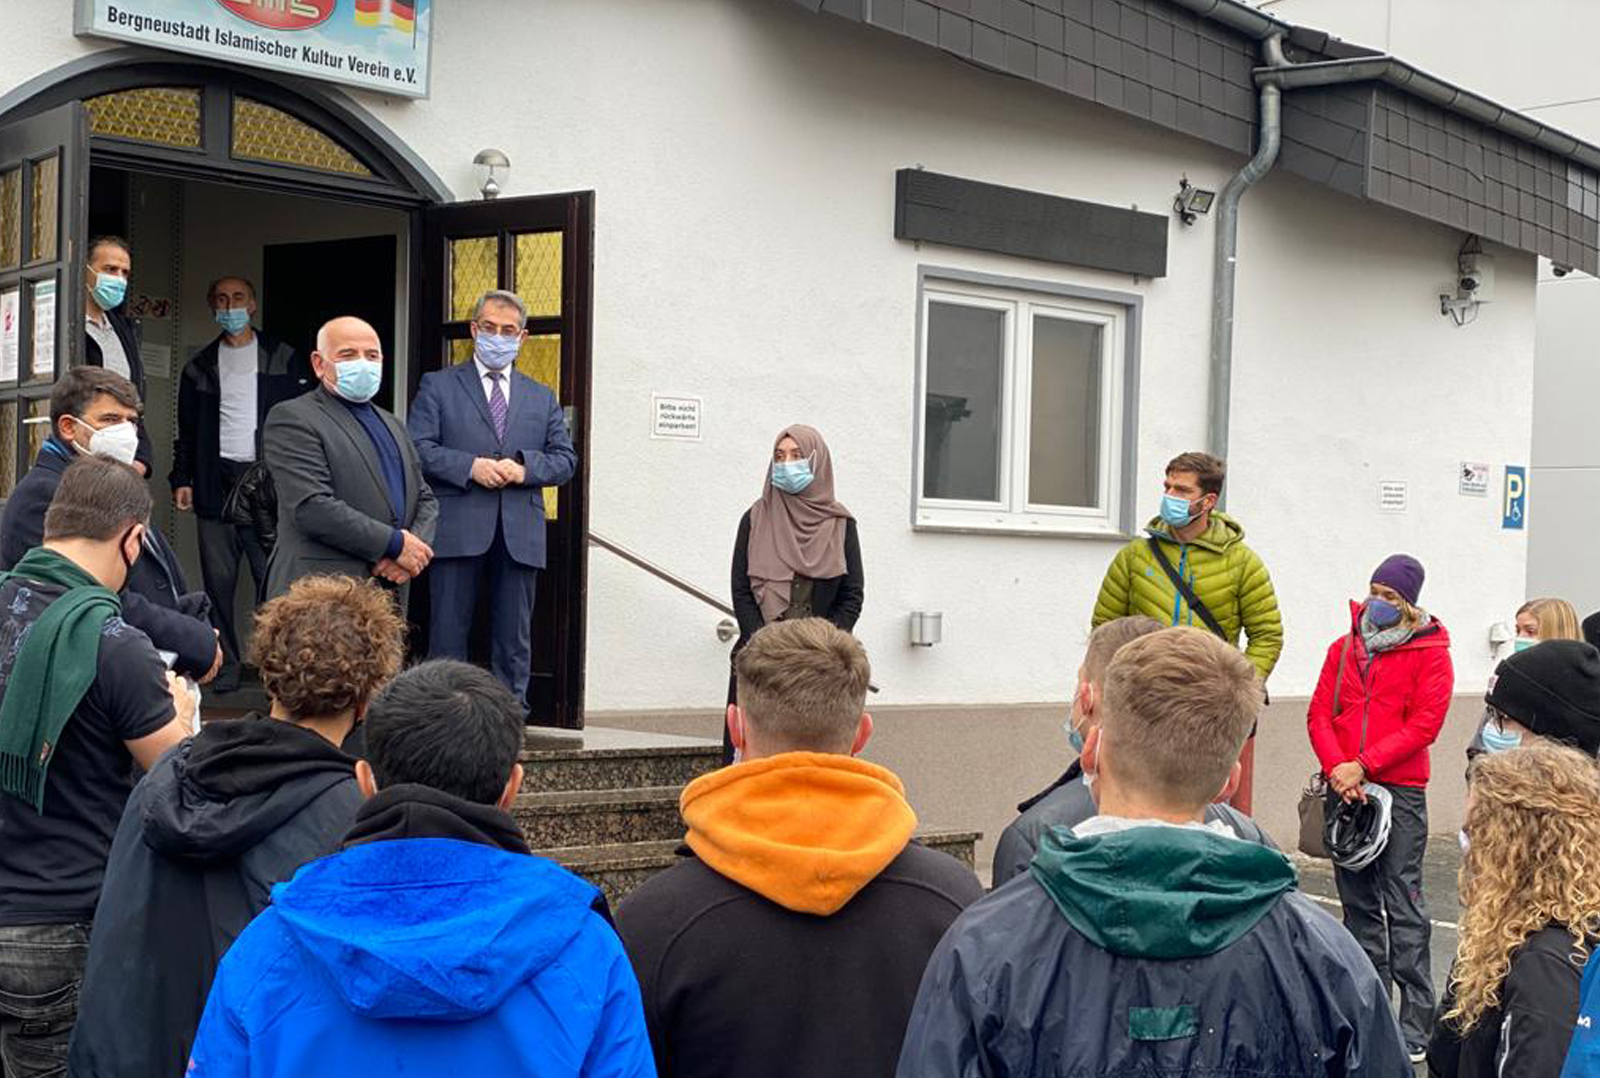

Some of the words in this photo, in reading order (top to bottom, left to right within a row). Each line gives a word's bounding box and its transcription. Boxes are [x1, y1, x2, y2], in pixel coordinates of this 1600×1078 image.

[107, 6, 211, 43] Bergneustadt
[215, 28, 297, 61] Islamischer
[302, 46, 343, 70] Kultur
[347, 55, 390, 79] Verein
[393, 66, 417, 84] e.V.
[660, 403, 676, 411] Bitte
[1505, 473, 1523, 518] P
